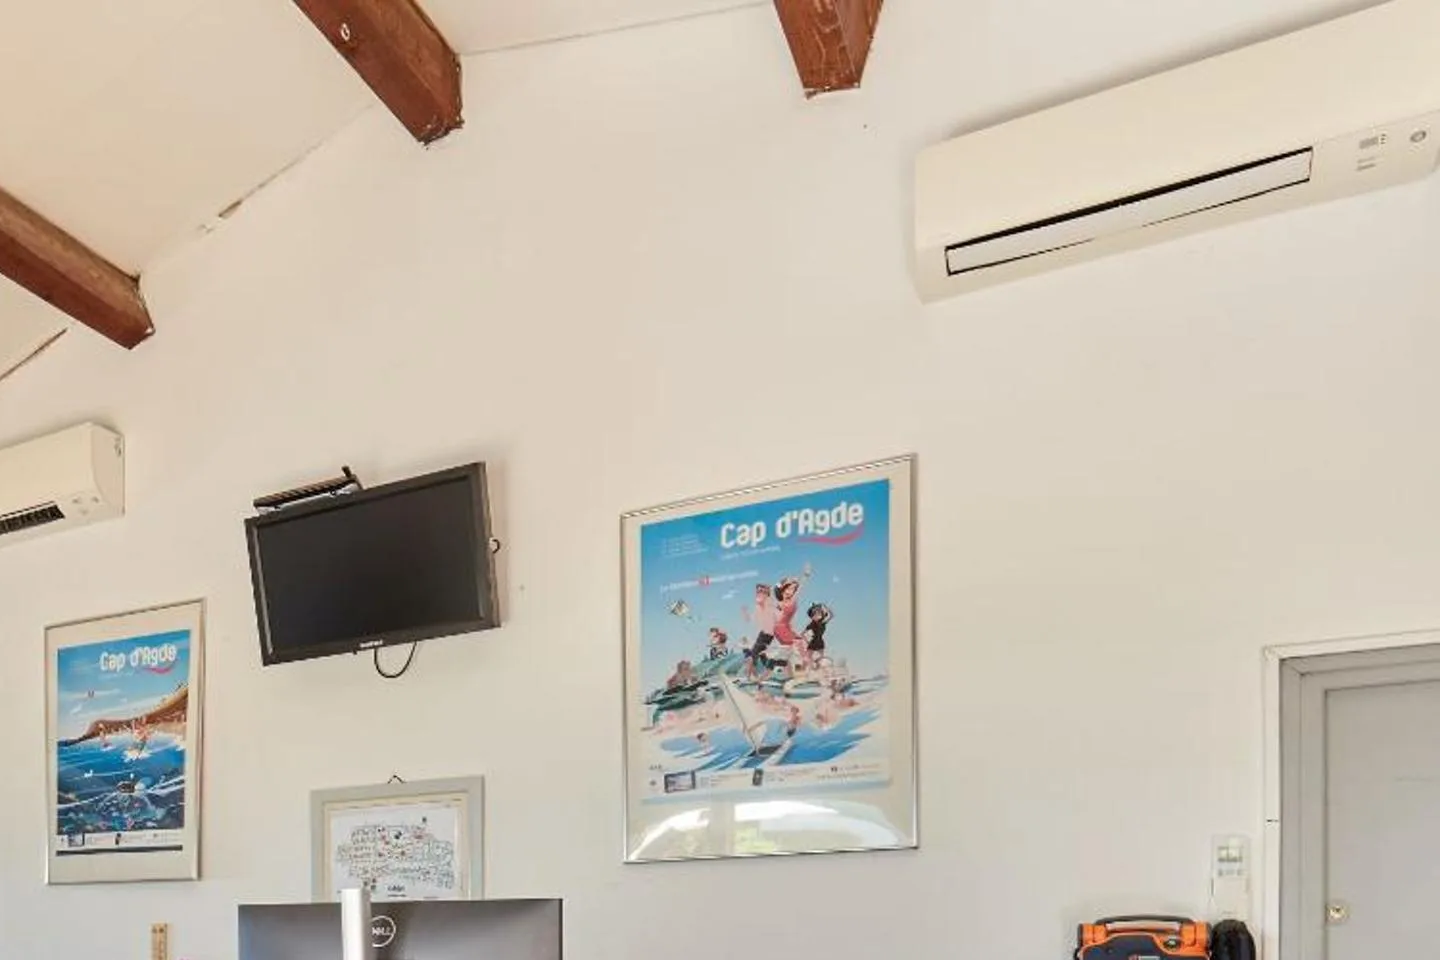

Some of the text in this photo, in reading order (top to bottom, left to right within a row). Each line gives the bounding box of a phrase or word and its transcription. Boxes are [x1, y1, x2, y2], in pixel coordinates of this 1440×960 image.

[720, 522, 766, 549] Cap
[775, 501, 864, 538] d'Agde
[100, 651, 126, 672] Cap
